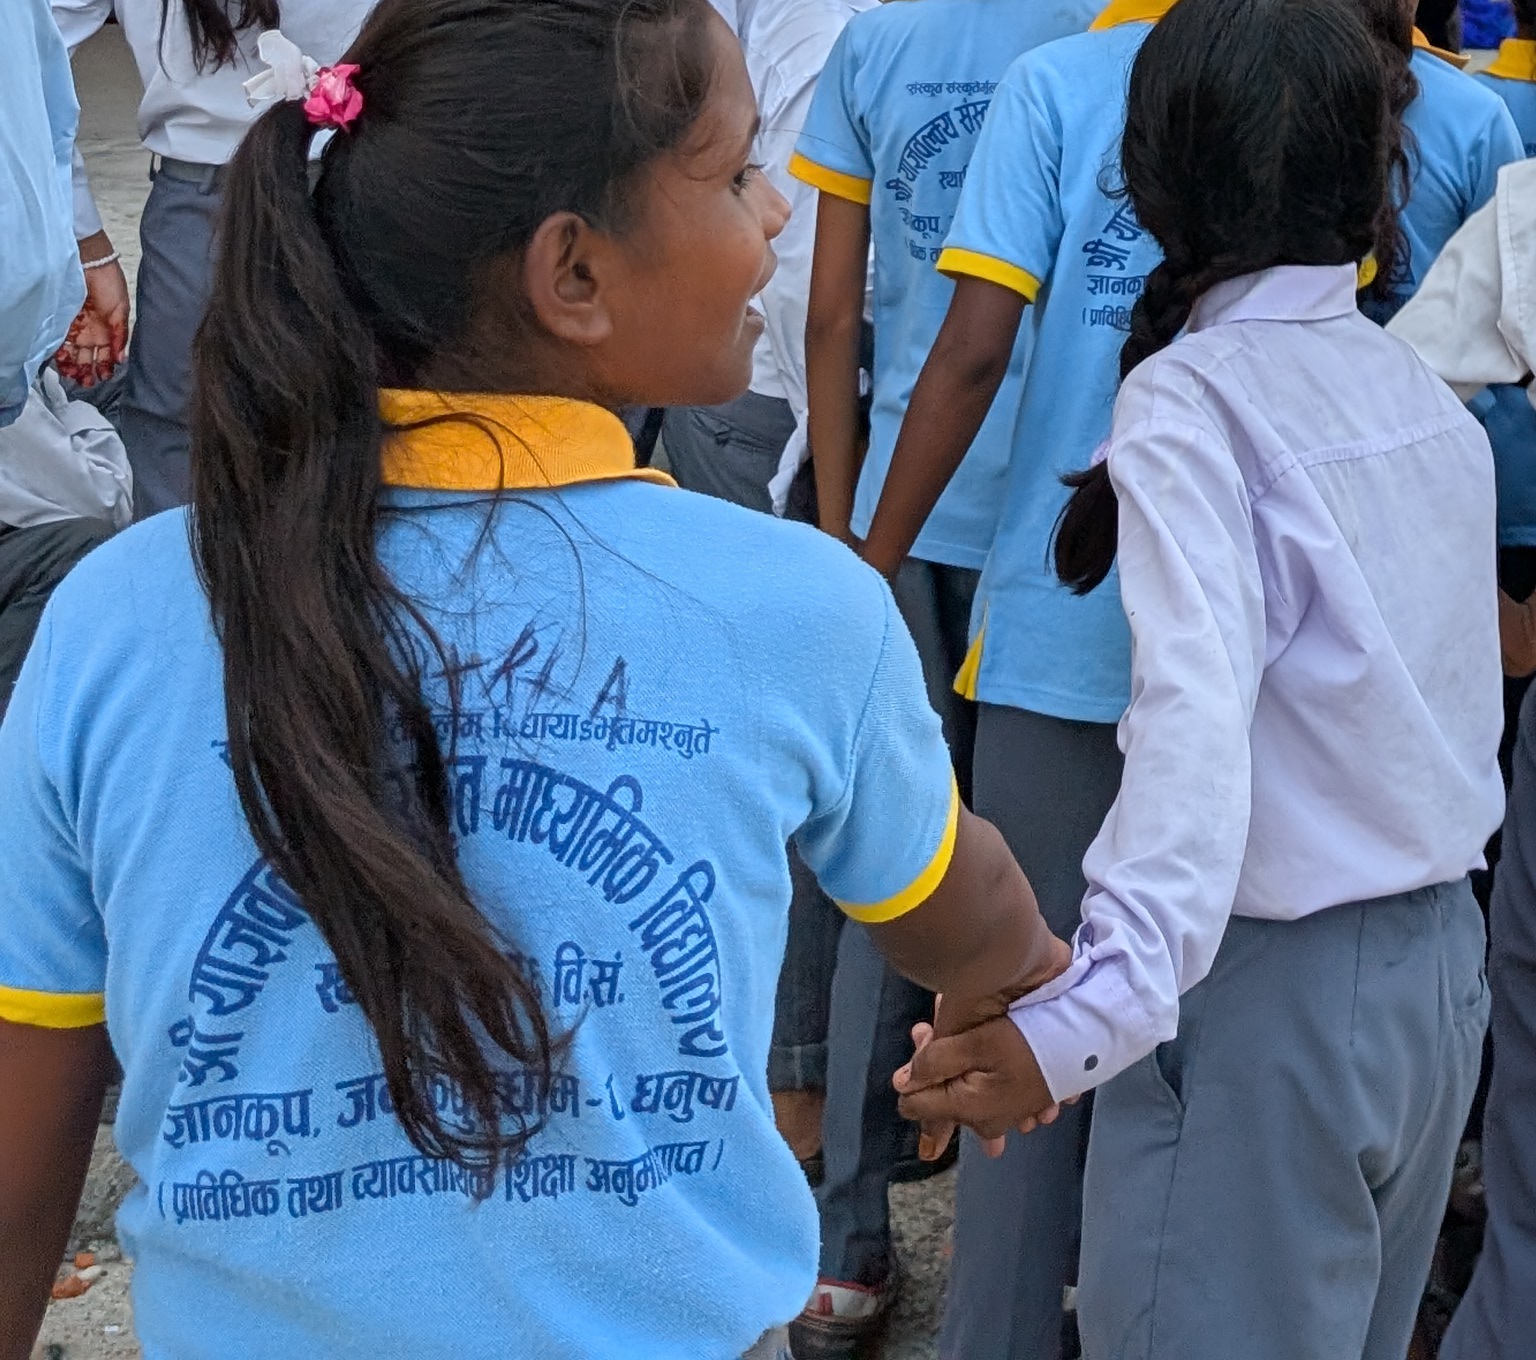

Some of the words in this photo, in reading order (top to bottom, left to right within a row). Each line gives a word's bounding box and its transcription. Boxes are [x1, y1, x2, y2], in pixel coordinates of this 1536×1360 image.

[494, 757, 675, 906] माध्यमिक
[631, 1069, 740, 1123] धनुषा
[286, 1169, 345, 1218] तथा
